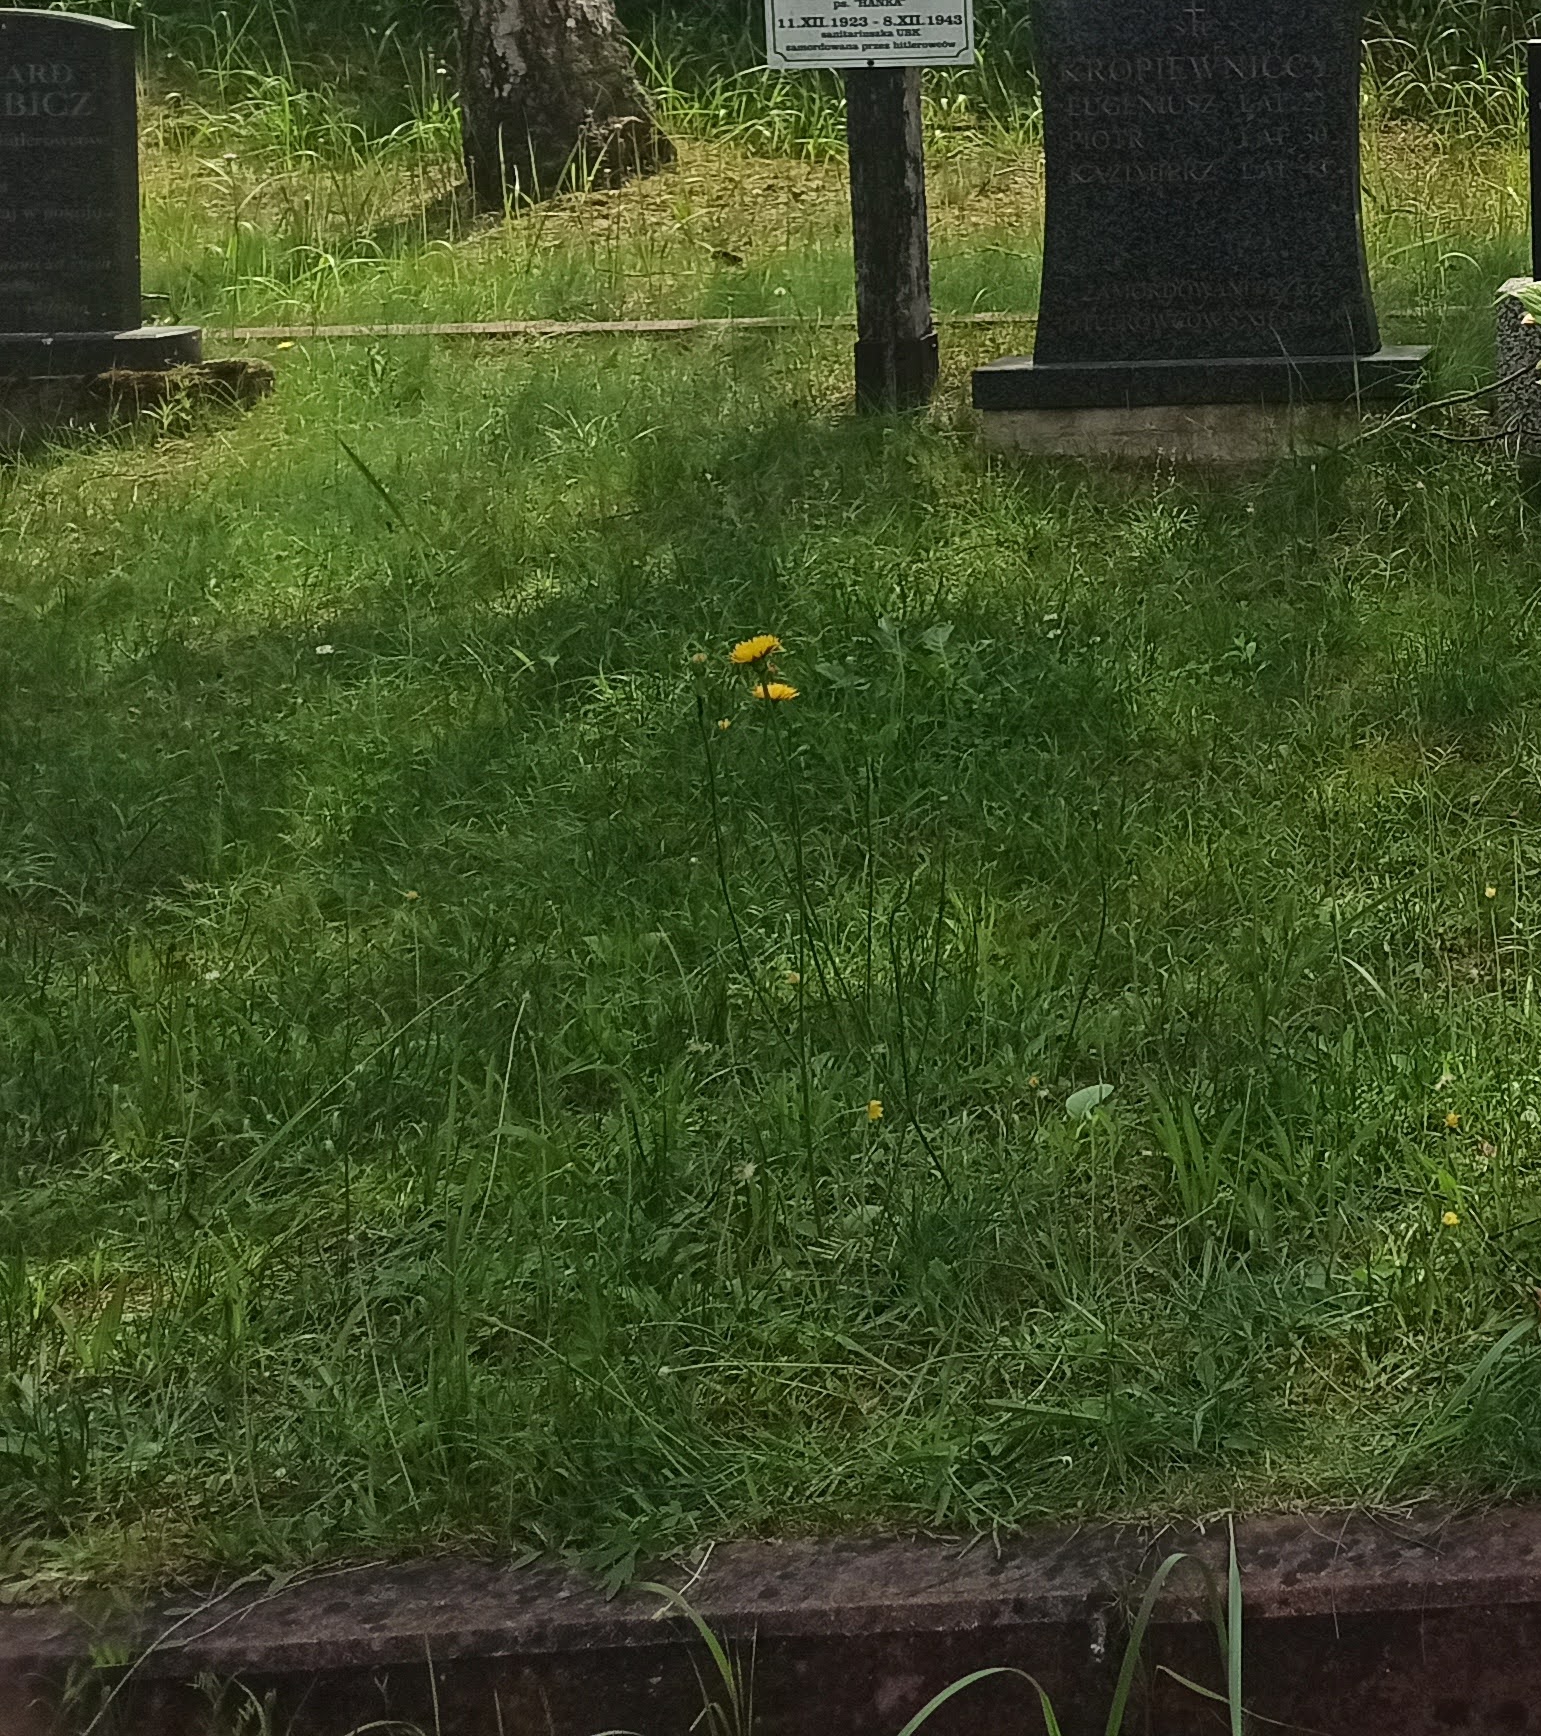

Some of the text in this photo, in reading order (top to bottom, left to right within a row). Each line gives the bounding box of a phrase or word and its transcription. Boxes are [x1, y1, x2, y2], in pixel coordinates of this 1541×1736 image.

[834, 0, 850, 10] ps.
[778, 15, 963, 29] 11.XII.1923 8.XII.1943
[786, 41, 956, 52] zamordowana przez hitlerowców
[1070, 129, 1144, 150] PIOTR
